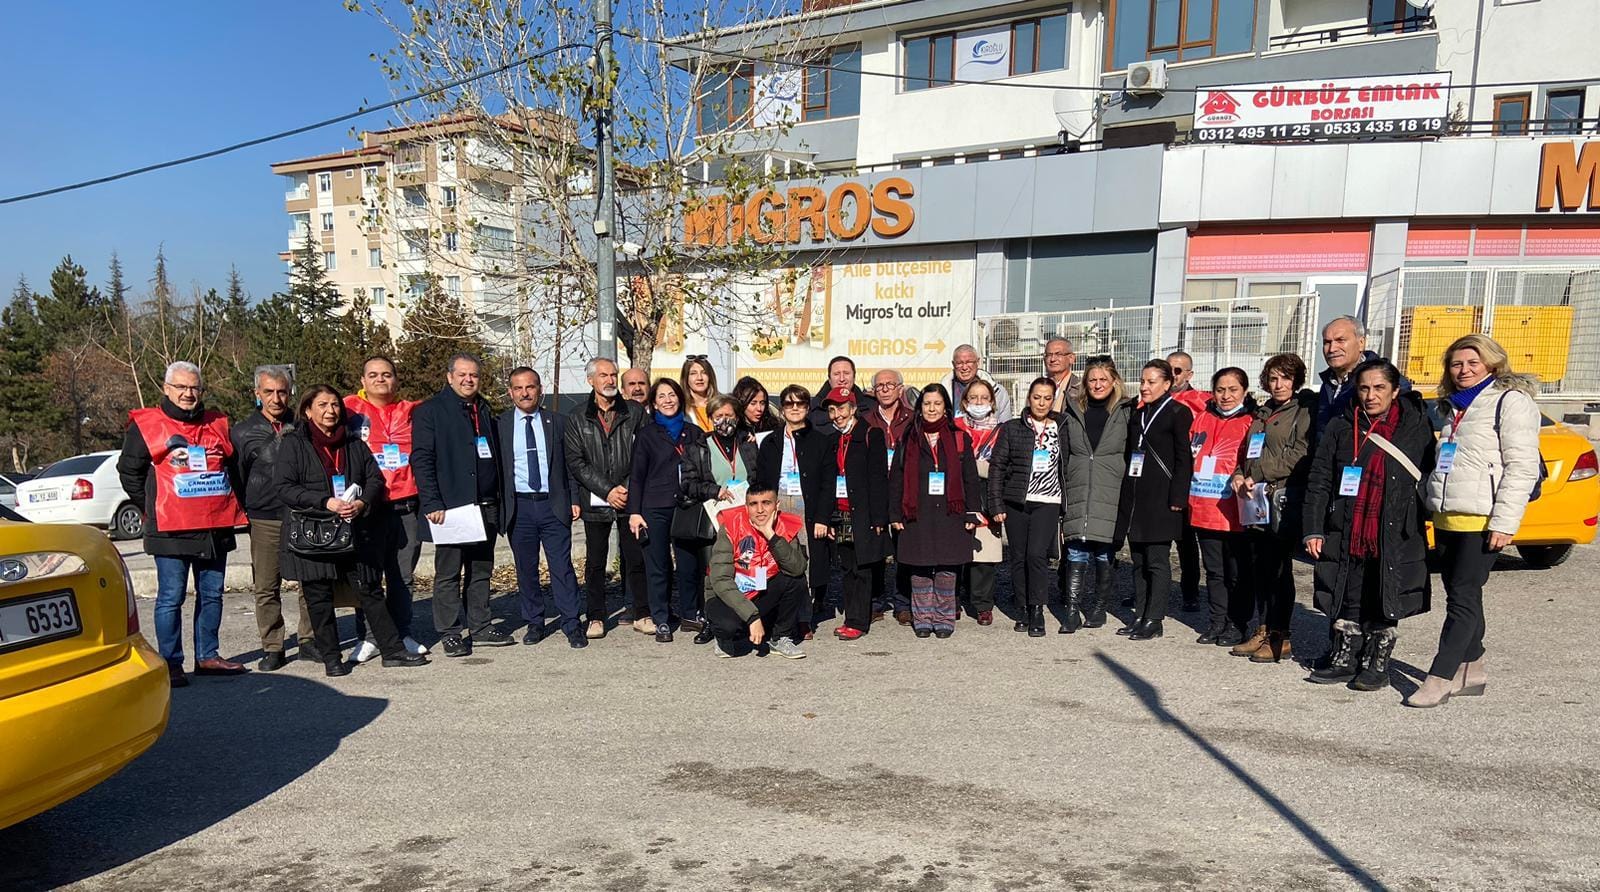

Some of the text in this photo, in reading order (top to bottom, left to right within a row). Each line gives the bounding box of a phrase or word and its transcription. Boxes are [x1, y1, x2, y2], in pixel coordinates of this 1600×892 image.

[1252, 82, 1441, 108] GÜRBÜZ EMLAK
[1311, 106, 1374, 121] BORSASI
[1199, 127, 1234, 141] 0312
[1238, 126, 1266, 139] 495
[1270, 126, 1287, 138] 11
[1292, 124, 1311, 136] 25
[1324, 122, 1363, 135] 0533
[1366, 121, 1394, 133] 435
[1399, 119, 1417, 132] 18
[1422, 118, 1442, 131] 19
[843, 258, 952, 278] Aile bütçesine
[875, 281, 915, 300] katkı
[917, 301, 951, 318] olur!
[26, 600, 73, 634] 6533
